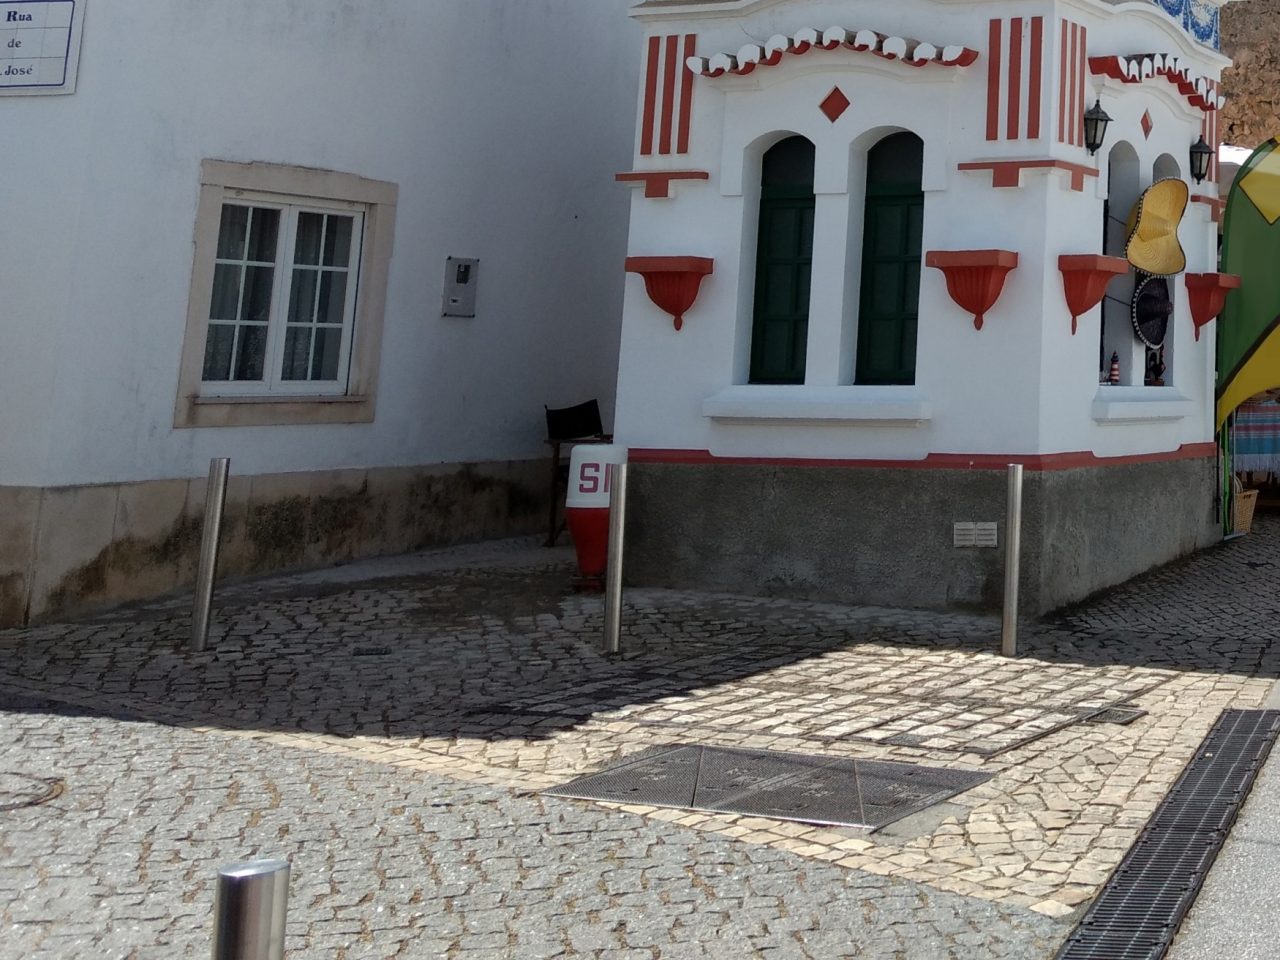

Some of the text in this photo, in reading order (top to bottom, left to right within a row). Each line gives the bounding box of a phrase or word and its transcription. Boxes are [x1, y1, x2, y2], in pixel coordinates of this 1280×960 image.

[6, 10, 33, 22] Rua
[7, 38, 22, 48] de
[4, 64, 33, 76] José
